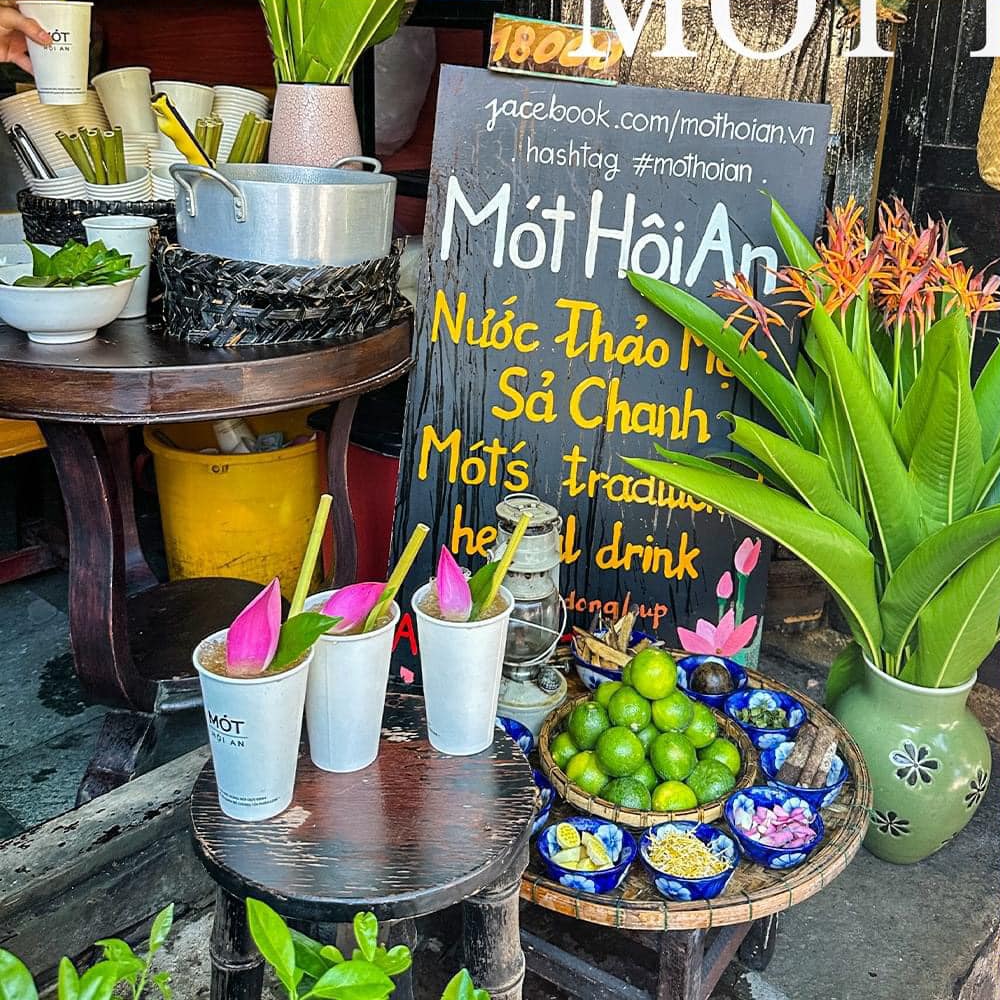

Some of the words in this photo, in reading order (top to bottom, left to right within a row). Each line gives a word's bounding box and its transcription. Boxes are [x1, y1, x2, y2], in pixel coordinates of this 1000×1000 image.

[48, 29, 71, 42] ÓT
[526, 136, 621, 181] hashtag
[632, 152, 753, 184] #mothoian
[440, 174, 577, 274] Mót
[431, 288, 541, 353] Nước
[553, 297, 670, 369] Thảo
[491, 366, 558, 424] Sả
[568, 376, 712, 444] Chanh
[595, 521, 701, 581] drink
[207, 710, 246, 735] MÓT
